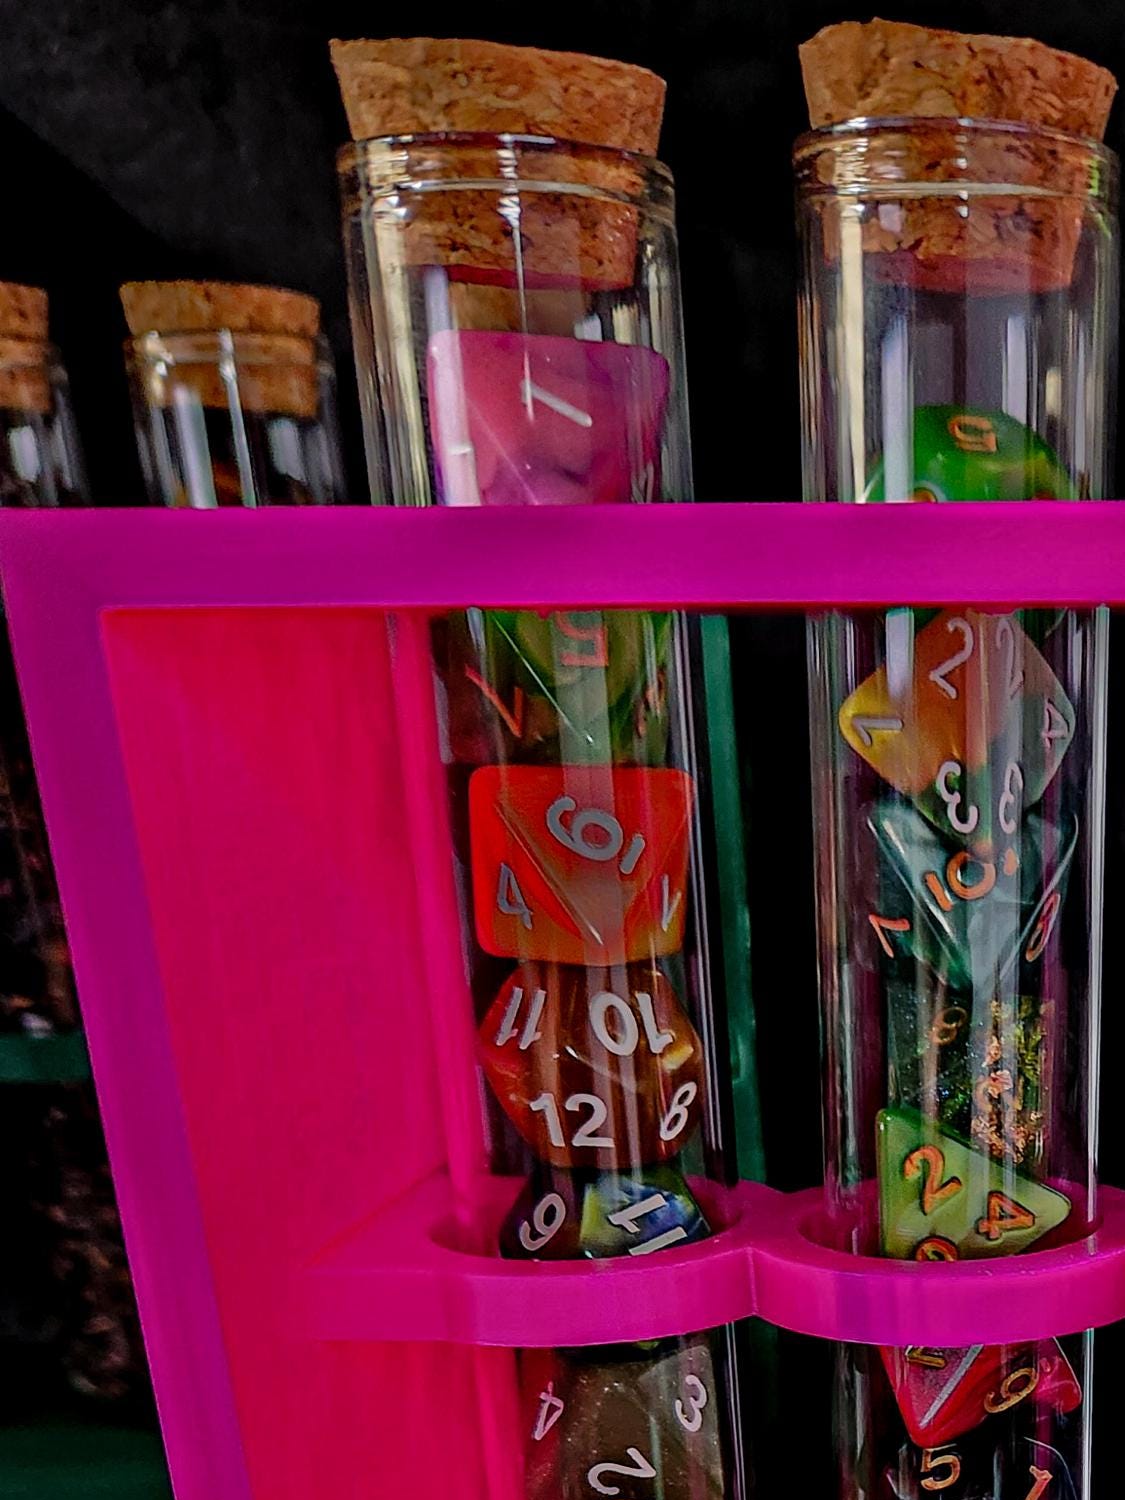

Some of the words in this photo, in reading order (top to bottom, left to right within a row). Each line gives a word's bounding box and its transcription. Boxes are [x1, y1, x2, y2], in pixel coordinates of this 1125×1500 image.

[930, 617, 974, 699] 2
[937, 760, 979, 835] 3
[497, 862, 534, 931] 4
[589, 991, 676, 1057] 10
[529, 1092, 616, 1148] 12
[660, 1081, 698, 1141] 8
[904, 1144, 963, 1215] 2
[977, 1190, 1036, 1241] 4
[533, 1380, 564, 1441] 4
[674, 1374, 708, 1432] 3
[587, 1447, 657, 1496] 2
[920, 1449, 962, 1491] 5
